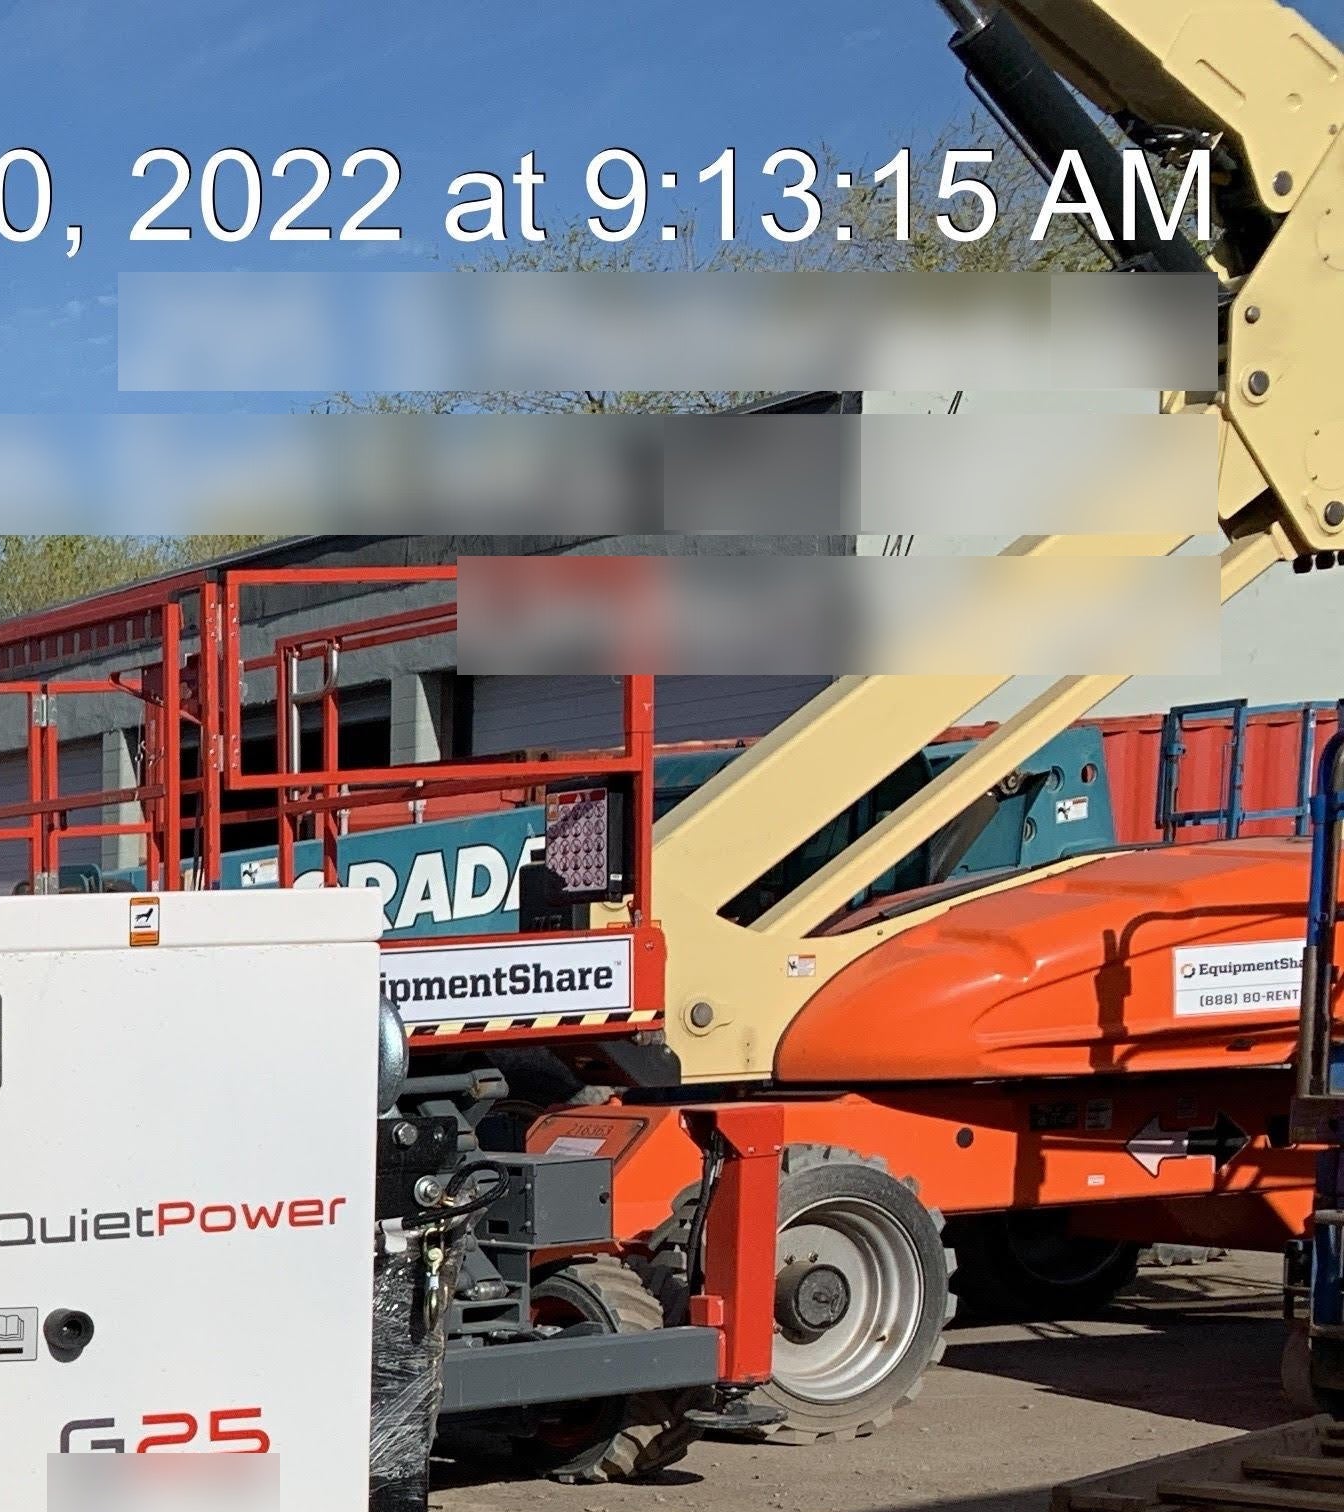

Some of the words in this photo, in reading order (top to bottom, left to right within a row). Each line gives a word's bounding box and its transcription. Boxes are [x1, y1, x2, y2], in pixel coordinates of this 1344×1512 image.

[1199, 957, 1304, 976] EquipmentSha
[380, 961, 613, 1010] ipmentShare
[1199, 992, 1238, 1007] (888)
[1243, 989, 1299, 1004] 80-RENT
[59, 1407, 270, 1453] G25
